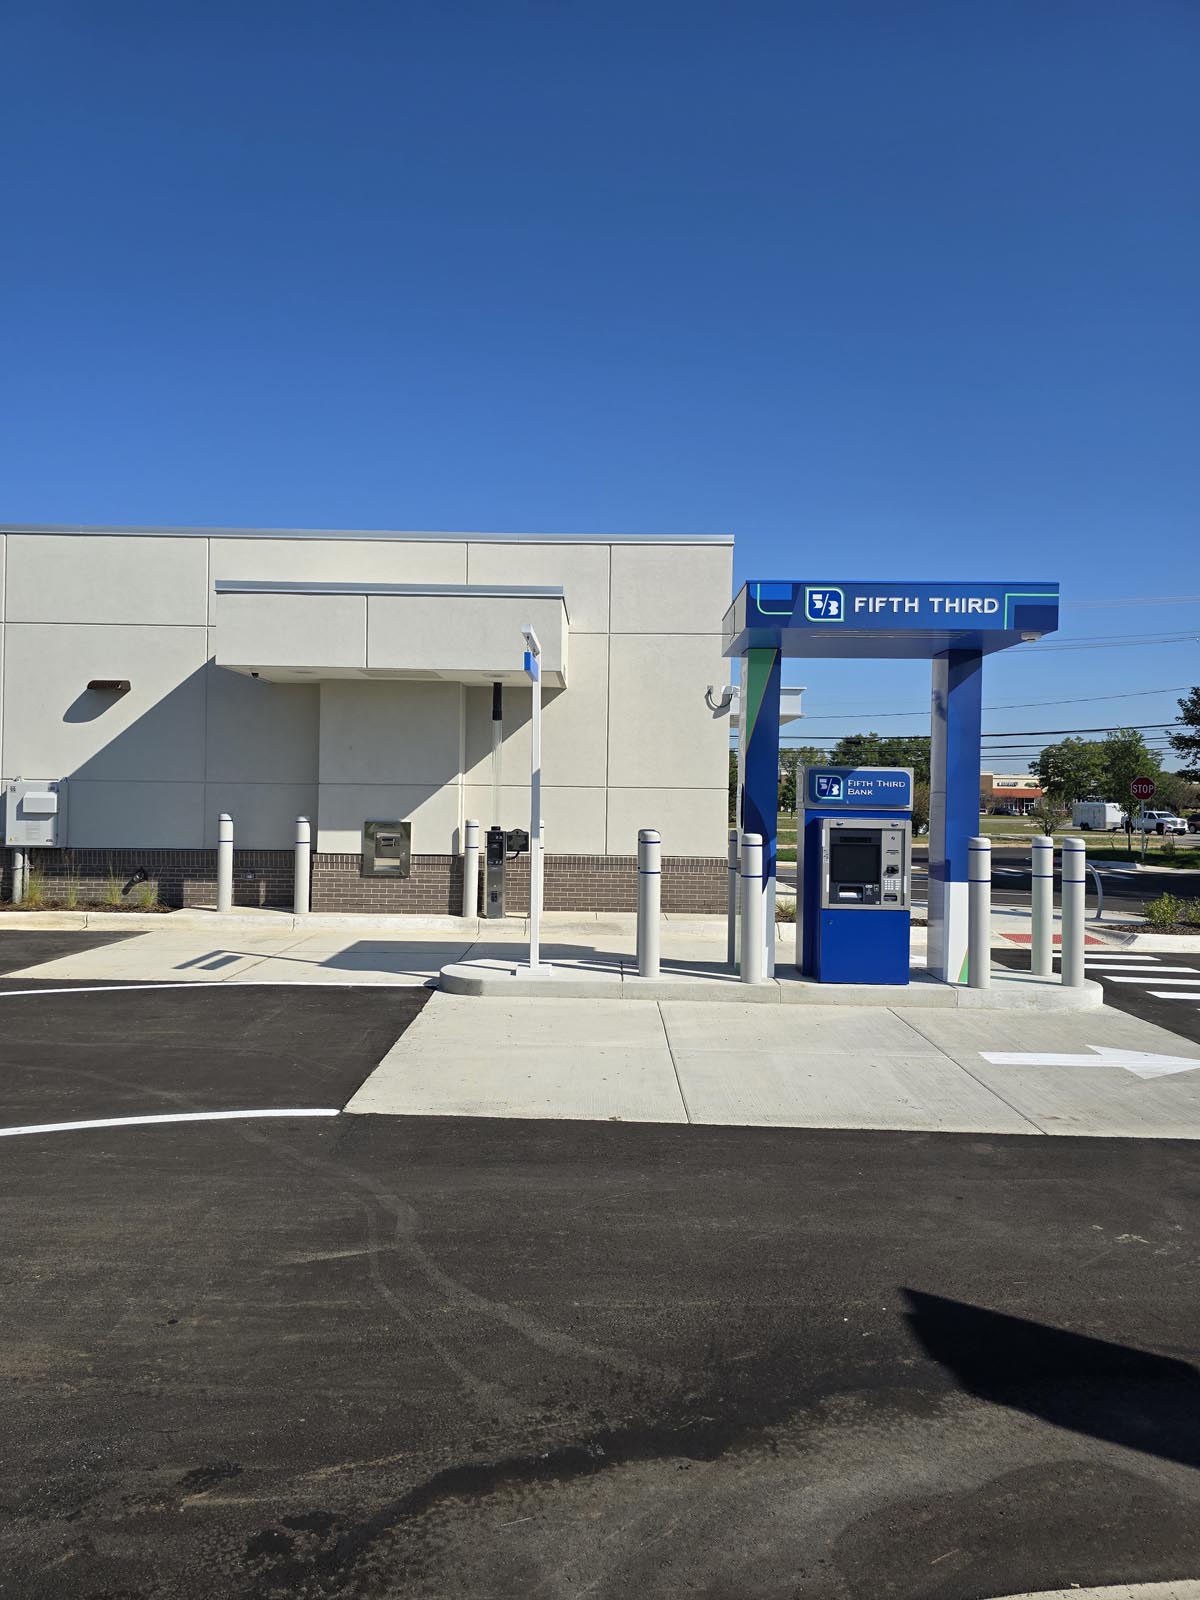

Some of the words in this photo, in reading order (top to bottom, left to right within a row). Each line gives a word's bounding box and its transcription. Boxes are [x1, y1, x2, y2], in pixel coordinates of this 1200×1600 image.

[854, 597, 920, 613] FIFTH
[928, 597, 1000, 614] THIRD
[847, 779, 873, 787] FIFTH
[876, 780, 906, 788] THIRD
[847, 788, 873, 796] BANK
[1132, 784, 1154, 794] STOP
